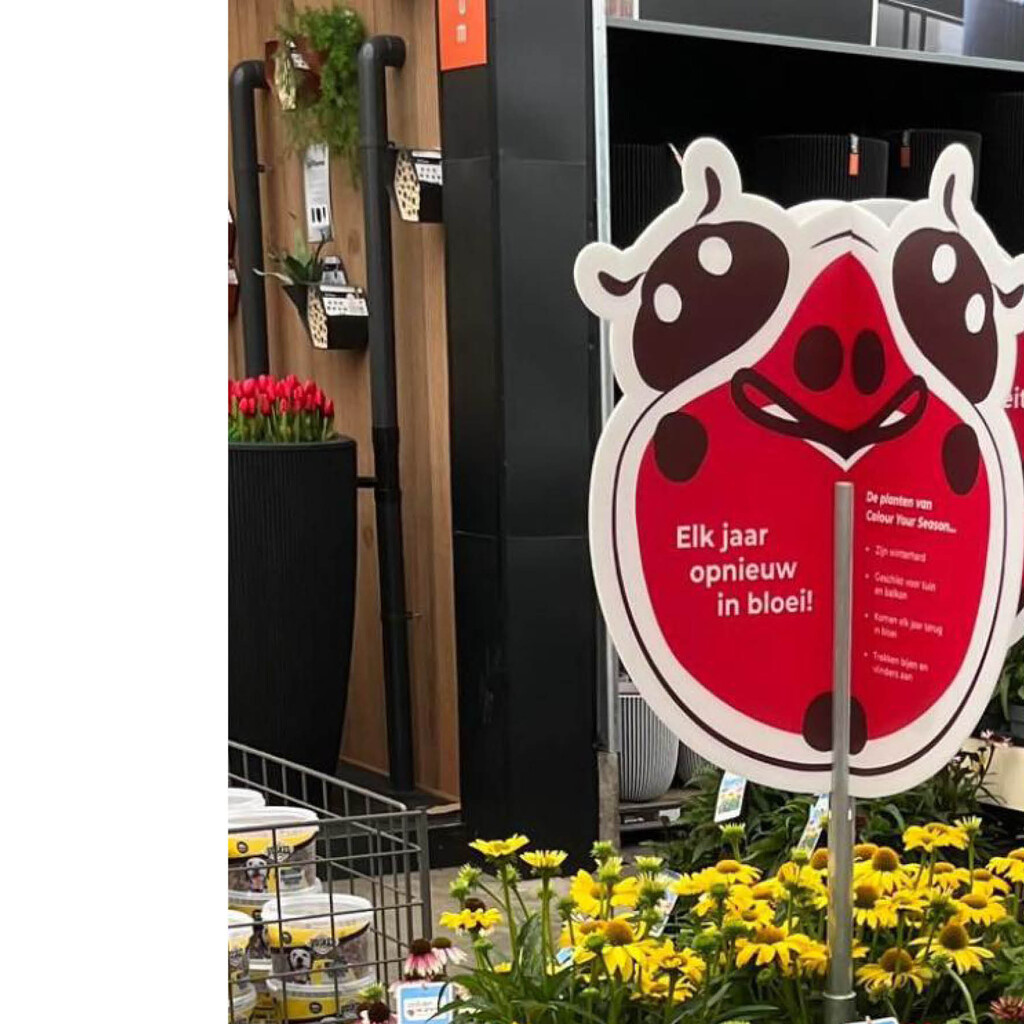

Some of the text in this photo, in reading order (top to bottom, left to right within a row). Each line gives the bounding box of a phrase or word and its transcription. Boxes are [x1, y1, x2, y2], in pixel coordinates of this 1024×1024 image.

[866, 490, 933, 511] De planten van
[866, 509, 894, 524] Colour
[896, 513, 916, 527] Your
[676, 521, 769, 553] Elk jaar
[690, 556, 798, 588] opnieuw
[717, 588, 813, 617] in bloei!
